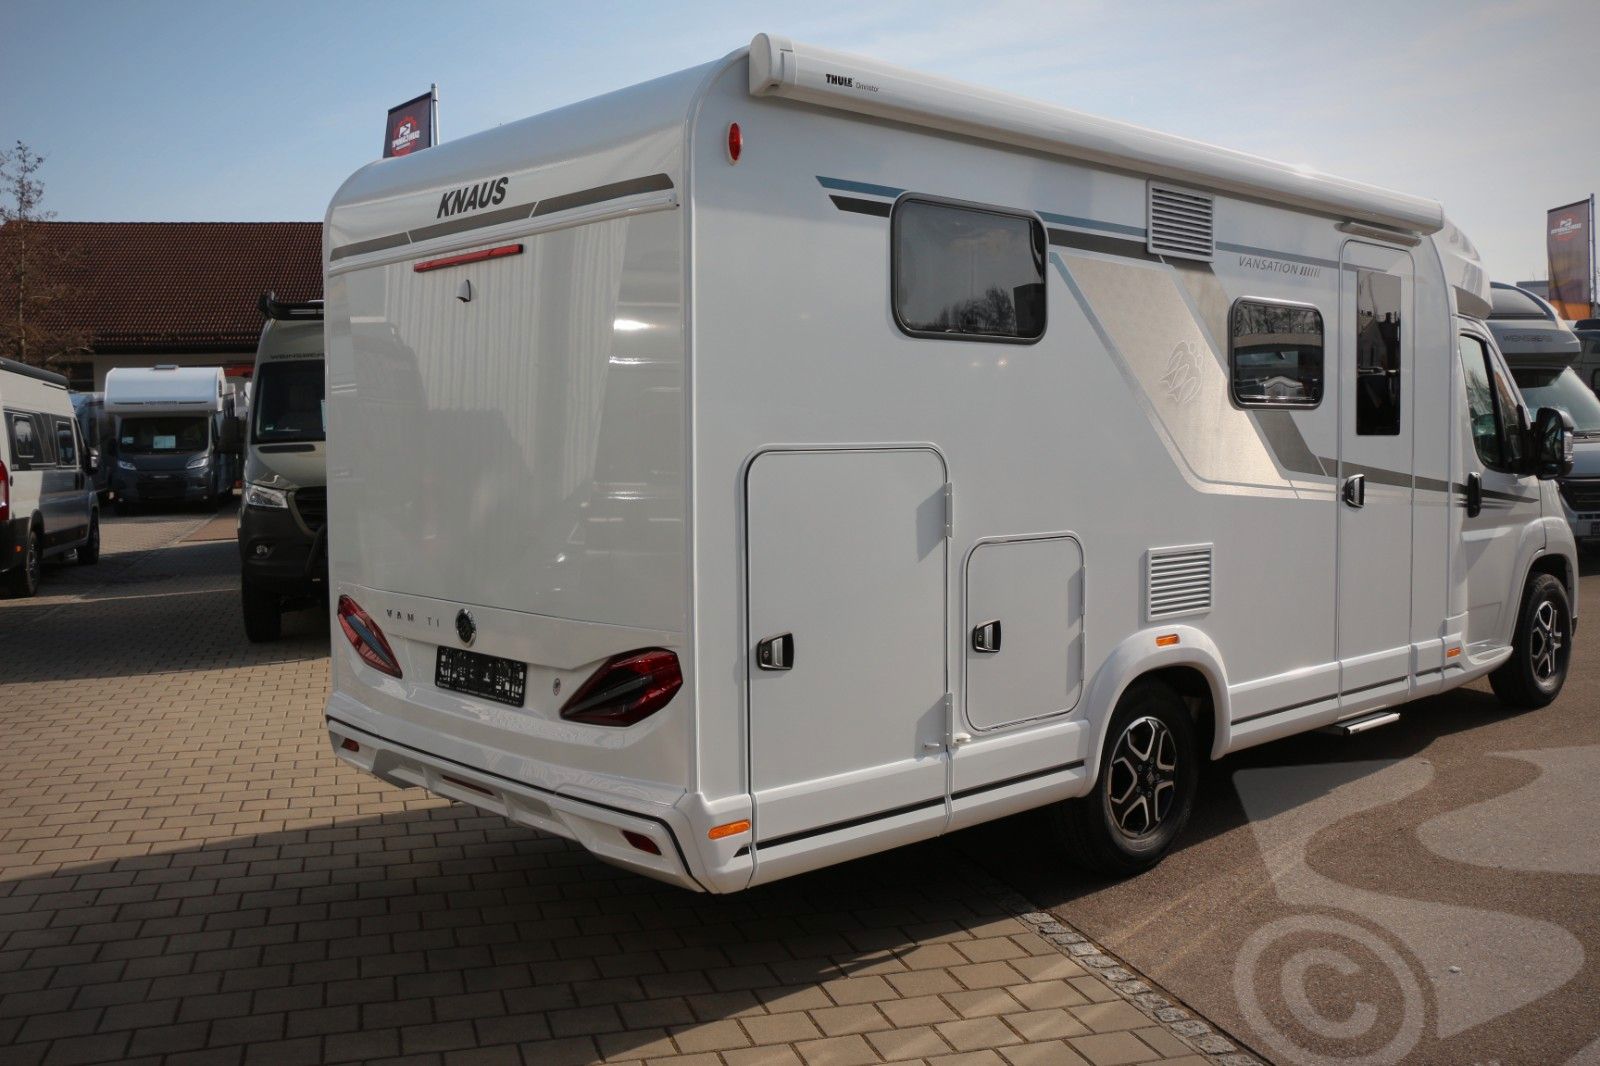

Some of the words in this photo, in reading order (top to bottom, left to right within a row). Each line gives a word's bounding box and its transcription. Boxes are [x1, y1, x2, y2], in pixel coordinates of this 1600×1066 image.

[825, 73, 853, 87] THULE
[436, 176, 509, 219] KNAUS
[1239, 255, 1298, 274] VANSATION
